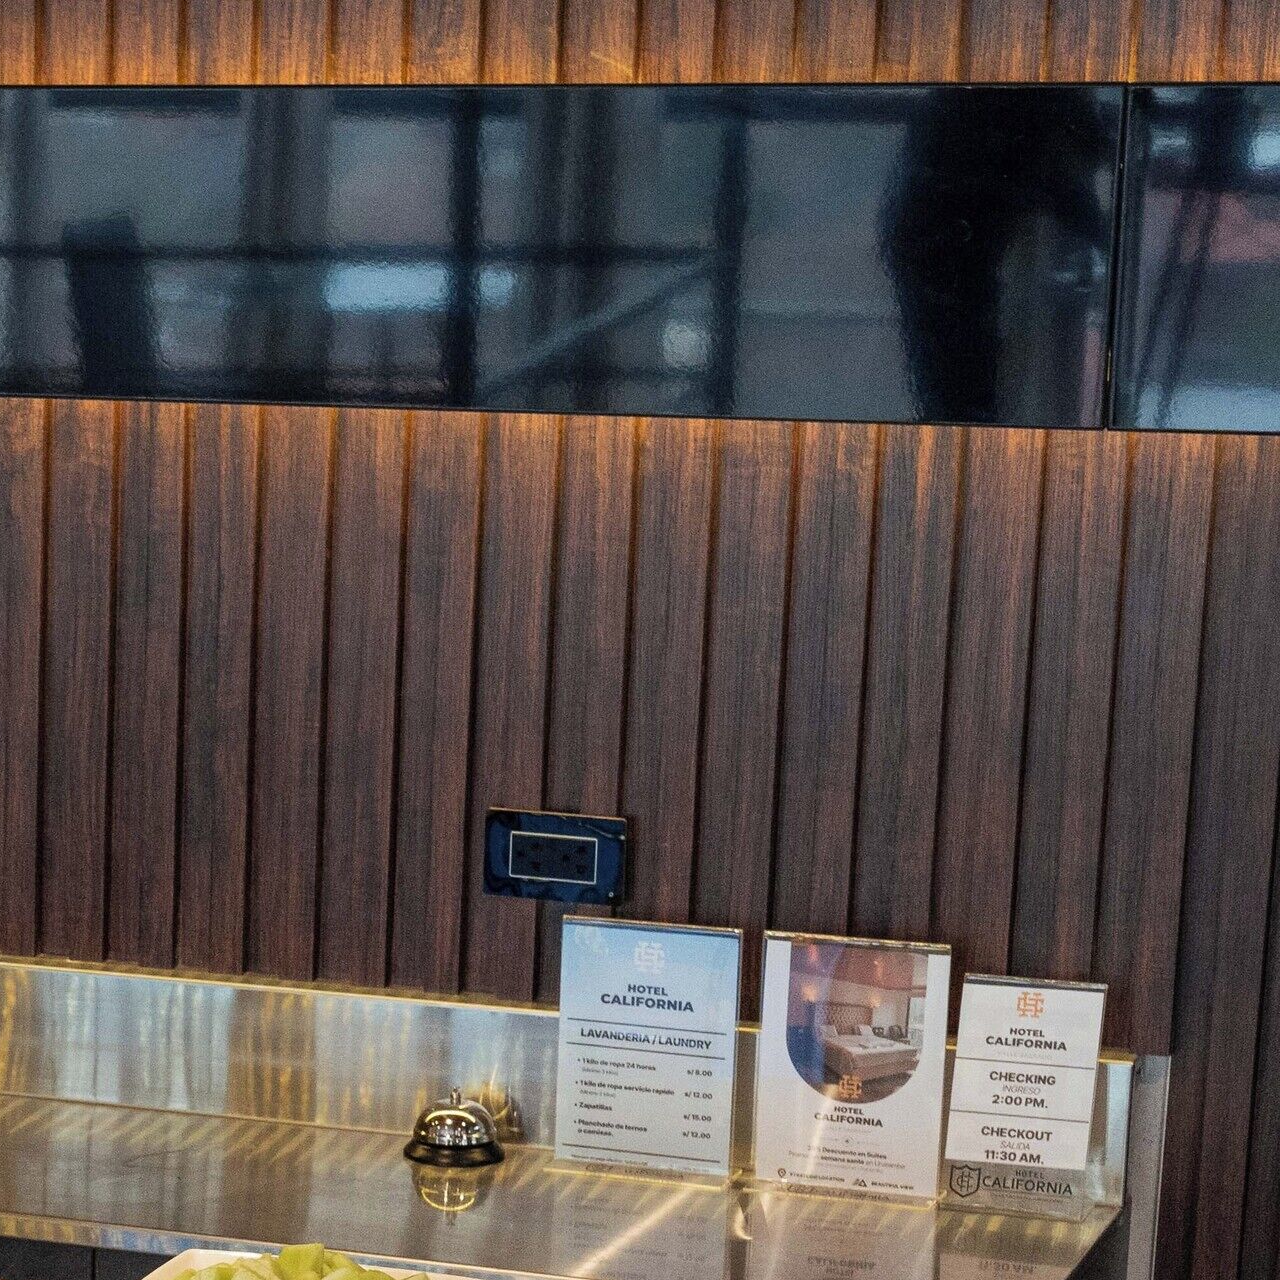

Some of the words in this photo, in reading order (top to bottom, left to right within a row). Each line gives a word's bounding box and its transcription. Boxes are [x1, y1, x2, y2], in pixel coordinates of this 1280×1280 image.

[627, 983, 669, 997] HOTEL
[600, 993, 695, 1013] CALIFORNIA
[1009, 1027, 1045, 1038] HOTEL
[658, 1036, 712, 1050] LAUNDRY
[985, 1035, 1067, 1051] CALIFORNIA
[989, 1070, 1057, 1086] CHECKING
[693, 1091, 713, 1100] 12.00
[1002, 1084, 1041, 1096] INGRESO
[992, 1094, 1023, 1106] 2:00
[1024, 1097, 1048, 1109] PM.
[834, 1105, 865, 1116] HOTEL
[814, 1112, 884, 1128] CALIFORNIA
[981, 1125, 1053, 1142] CHECKOUT
[1000, 1140, 1030, 1150] SALIDA
[984, 1149, 1017, 1161] 11:30
[1018, 1152, 1044, 1165] AM.
[1015, 1169, 1044, 1180] HOTEL
[982, 1175, 1073, 1196] CALIFORNIA
